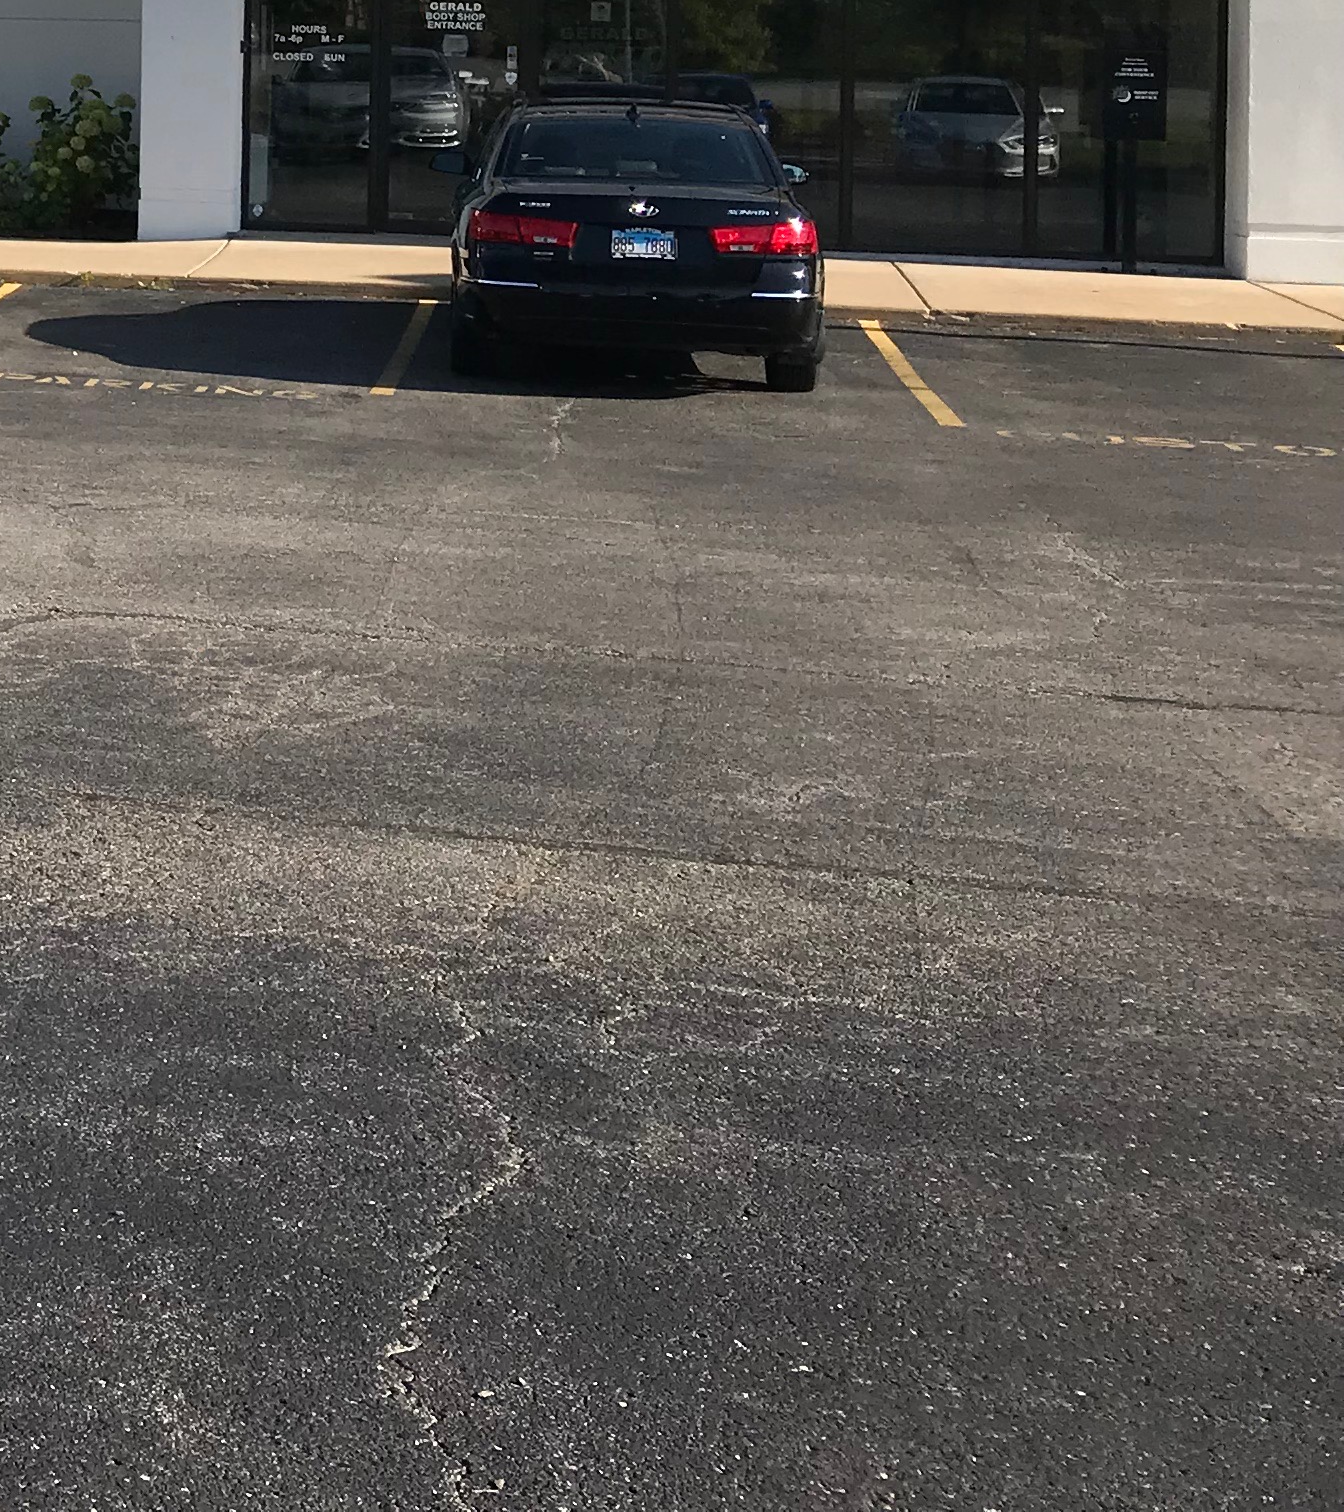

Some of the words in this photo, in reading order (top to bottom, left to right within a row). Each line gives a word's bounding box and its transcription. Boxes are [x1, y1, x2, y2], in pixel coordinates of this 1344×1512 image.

[429, 1, 482, 11] GERALD
[425, 11, 454, 21] BODY
[457, 12, 486, 21] SHOP
[292, 25, 327, 34] HOURS
[427, 20, 484, 30] ENTRANCE
[272, 52, 314, 61] CLOSED
